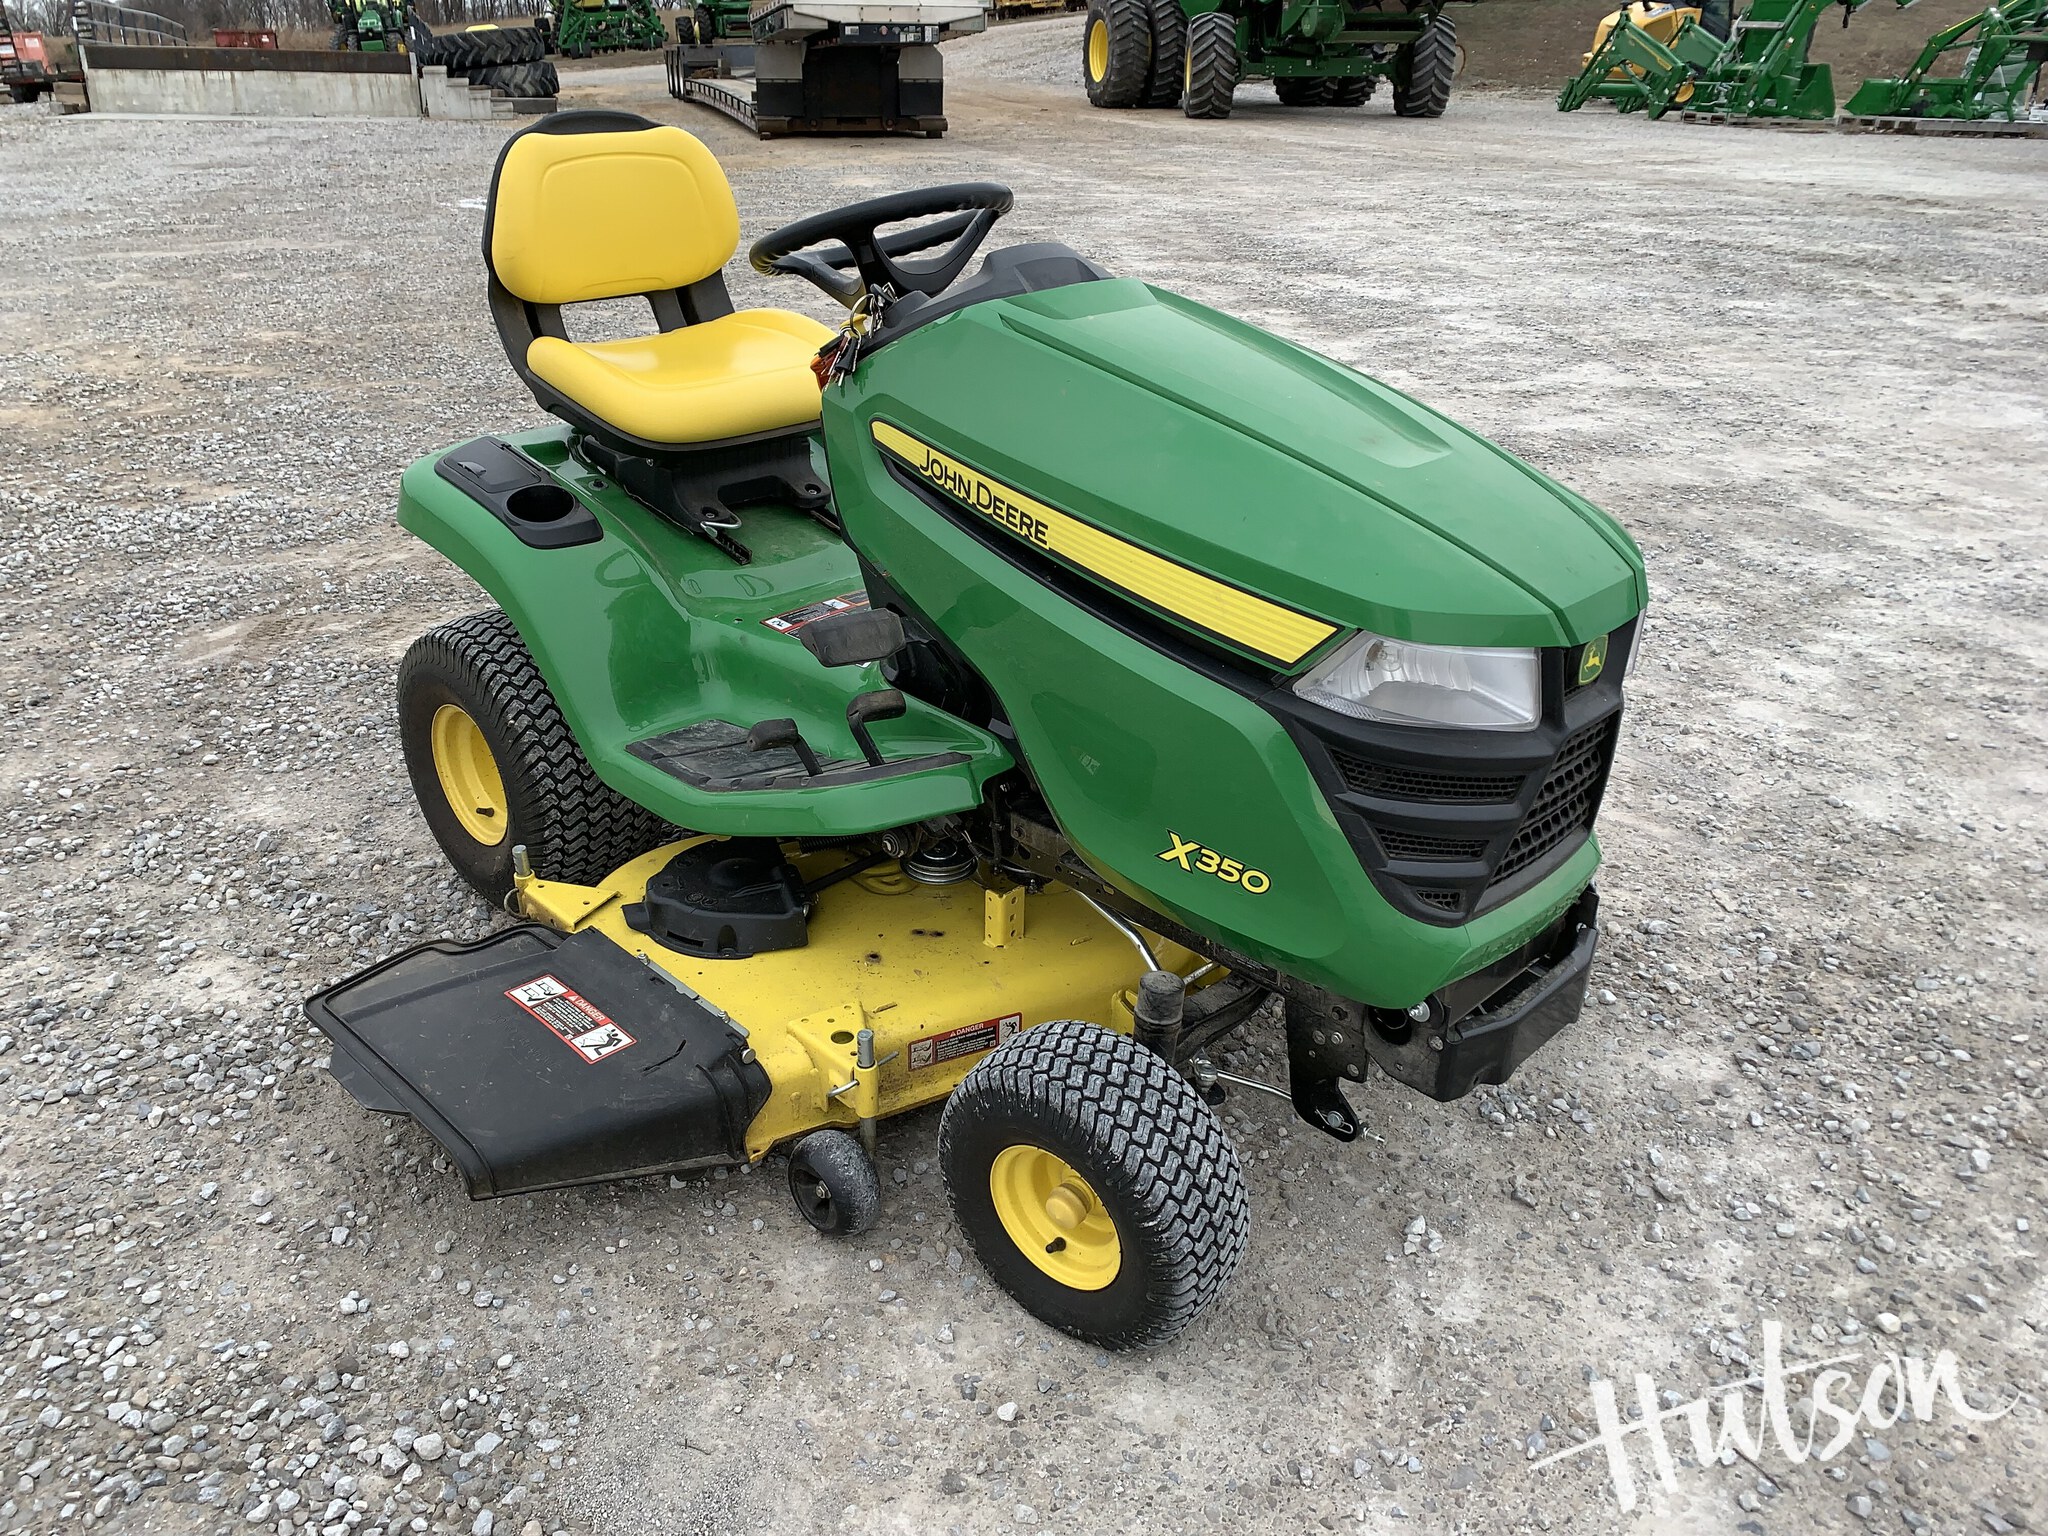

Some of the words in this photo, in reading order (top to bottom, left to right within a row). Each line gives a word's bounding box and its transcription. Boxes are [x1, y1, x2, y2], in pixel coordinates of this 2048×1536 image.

[919, 448, 972, 503] JOHN
[976, 479, 1049, 547] DEERE
[1155, 829, 1271, 894] X350
[575, 997, 606, 1021] DANGER
[956, 1022, 984, 1036] DANGER
